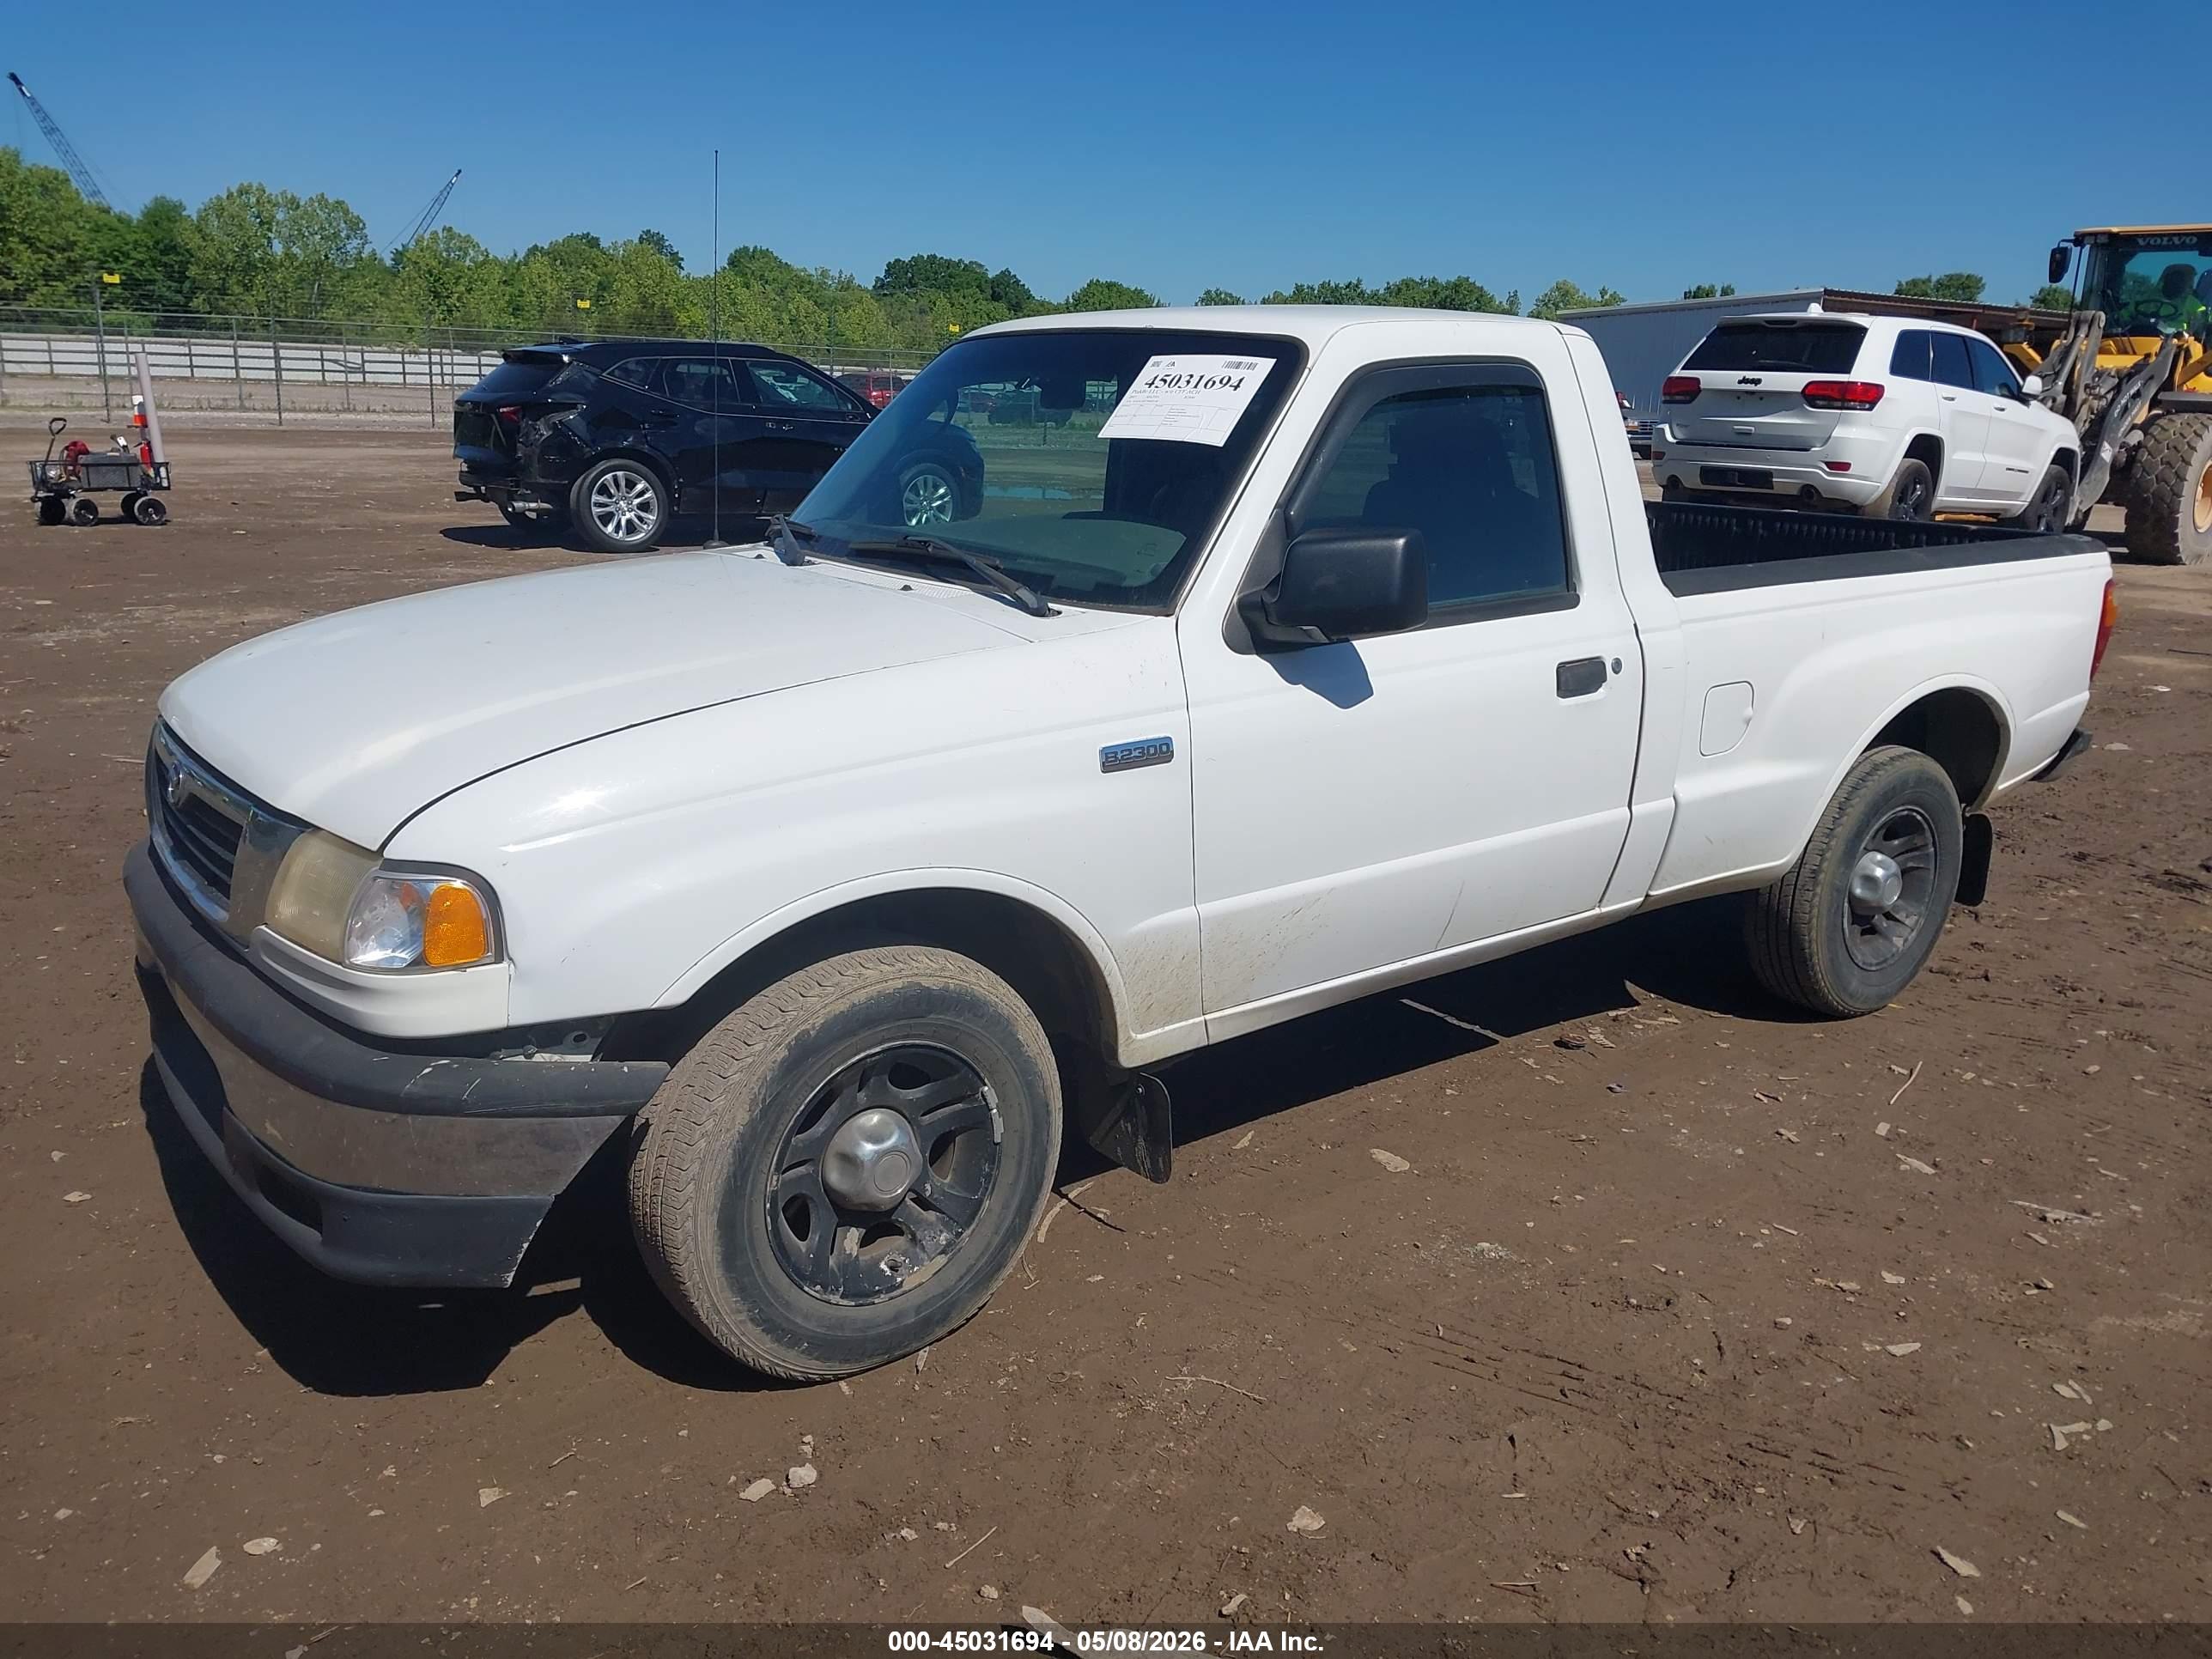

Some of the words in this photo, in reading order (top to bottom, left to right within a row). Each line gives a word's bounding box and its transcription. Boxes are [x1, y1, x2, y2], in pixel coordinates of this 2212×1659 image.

[2137, 236, 2198, 246] VOLVO
[1144, 373, 1247, 392] 45031694
[1737, 374, 1763, 387] Jeep
[1103, 742, 1172, 766] B2300
